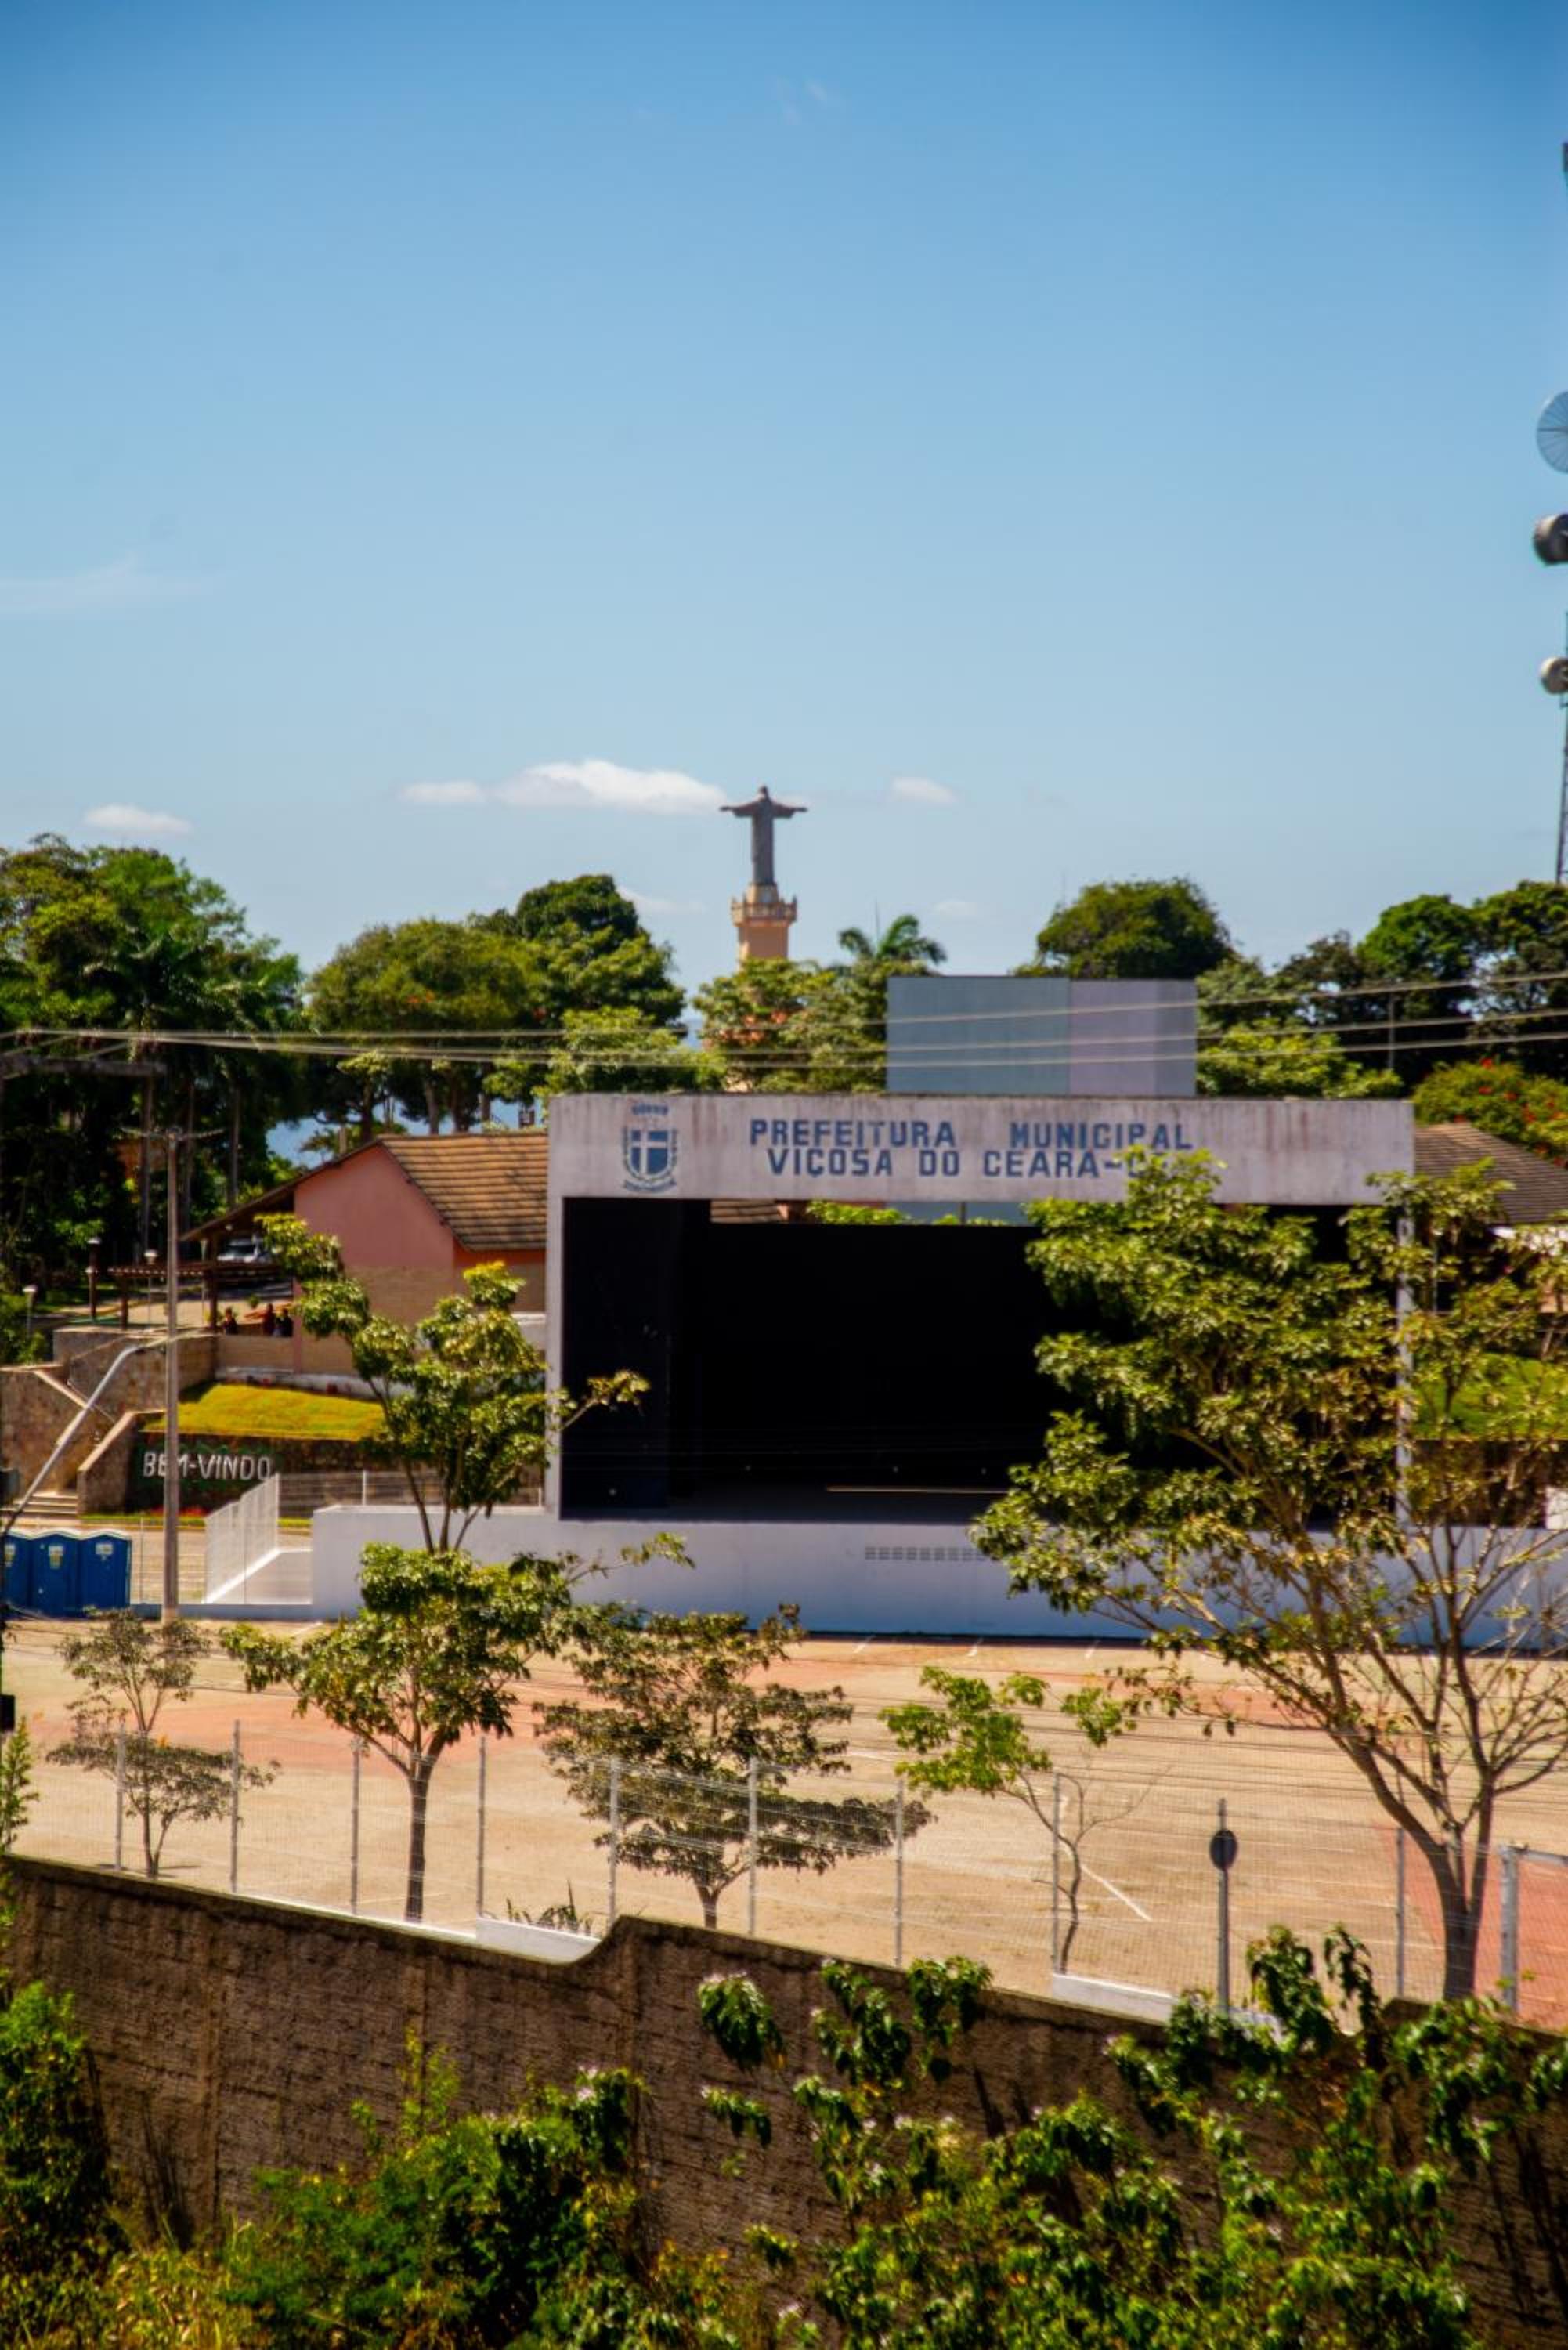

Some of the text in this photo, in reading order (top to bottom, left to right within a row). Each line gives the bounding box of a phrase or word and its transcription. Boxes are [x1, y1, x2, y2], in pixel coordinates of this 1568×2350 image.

[750, 1119, 1193, 1151] PREFEITURA MUNICIPAL
[768, 1148, 893, 1177] VIÇOSA
[919, 1149, 959, 1177] DO
